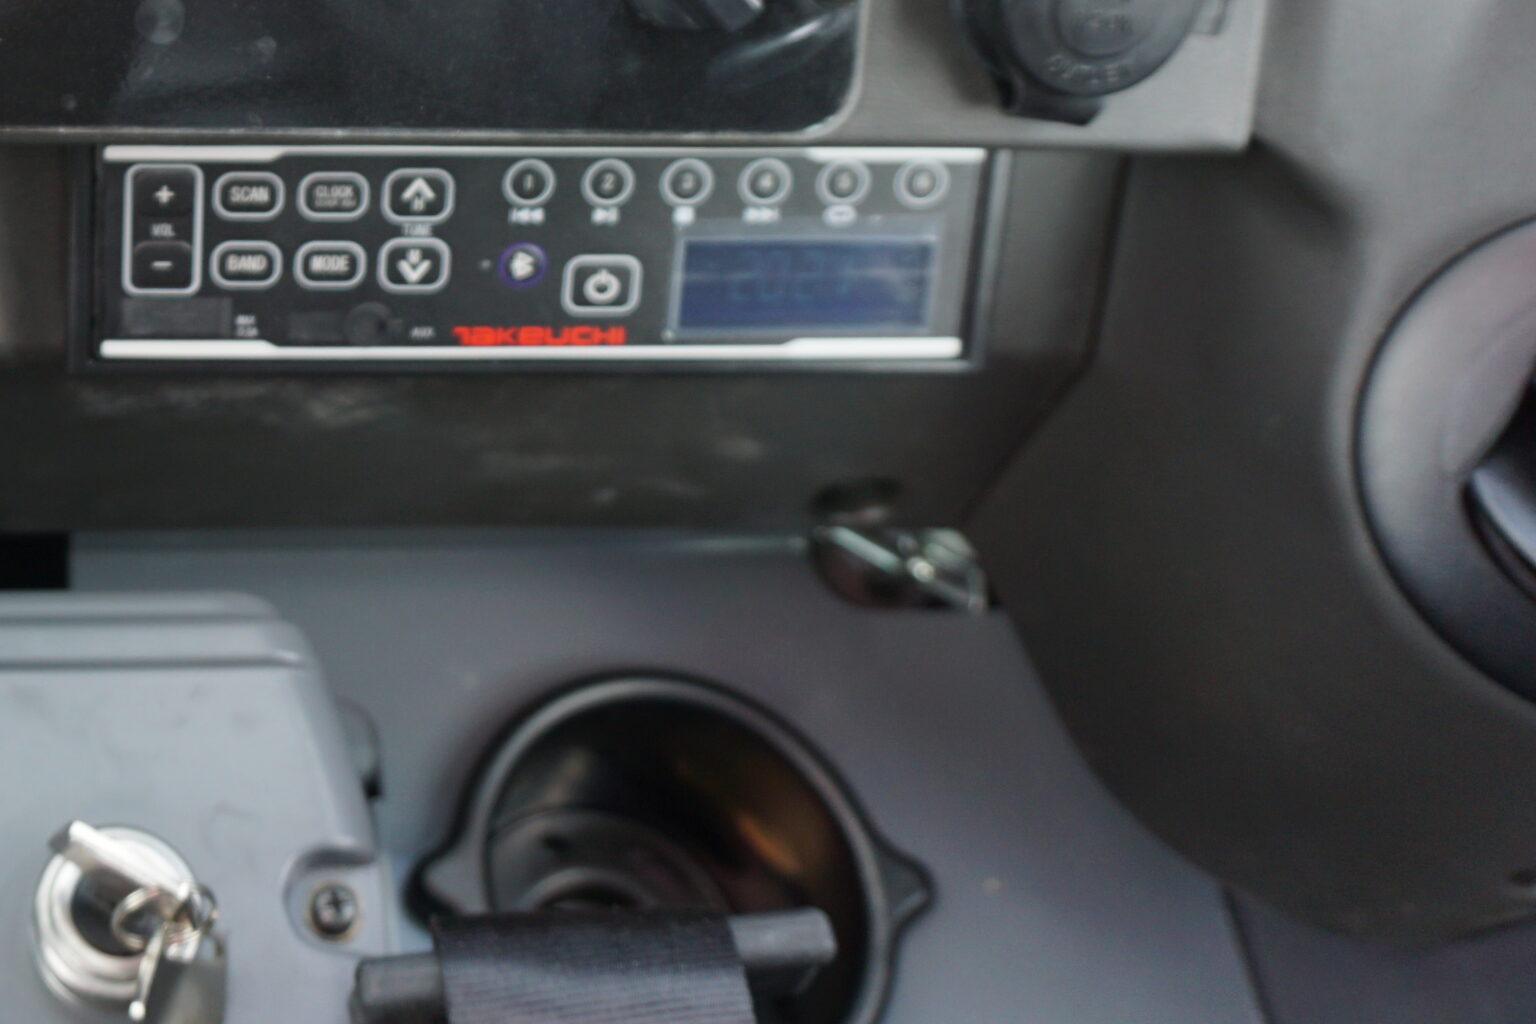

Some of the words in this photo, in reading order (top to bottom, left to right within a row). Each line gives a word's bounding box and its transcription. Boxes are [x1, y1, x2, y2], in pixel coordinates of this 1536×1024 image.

[602, 175, 615, 190] 2
[230, 186, 270, 203] SCAN
[226, 255, 267, 272] BAND
[310, 255, 350, 272] MODE
[452, 326, 625, 346] TAKEUCHI
